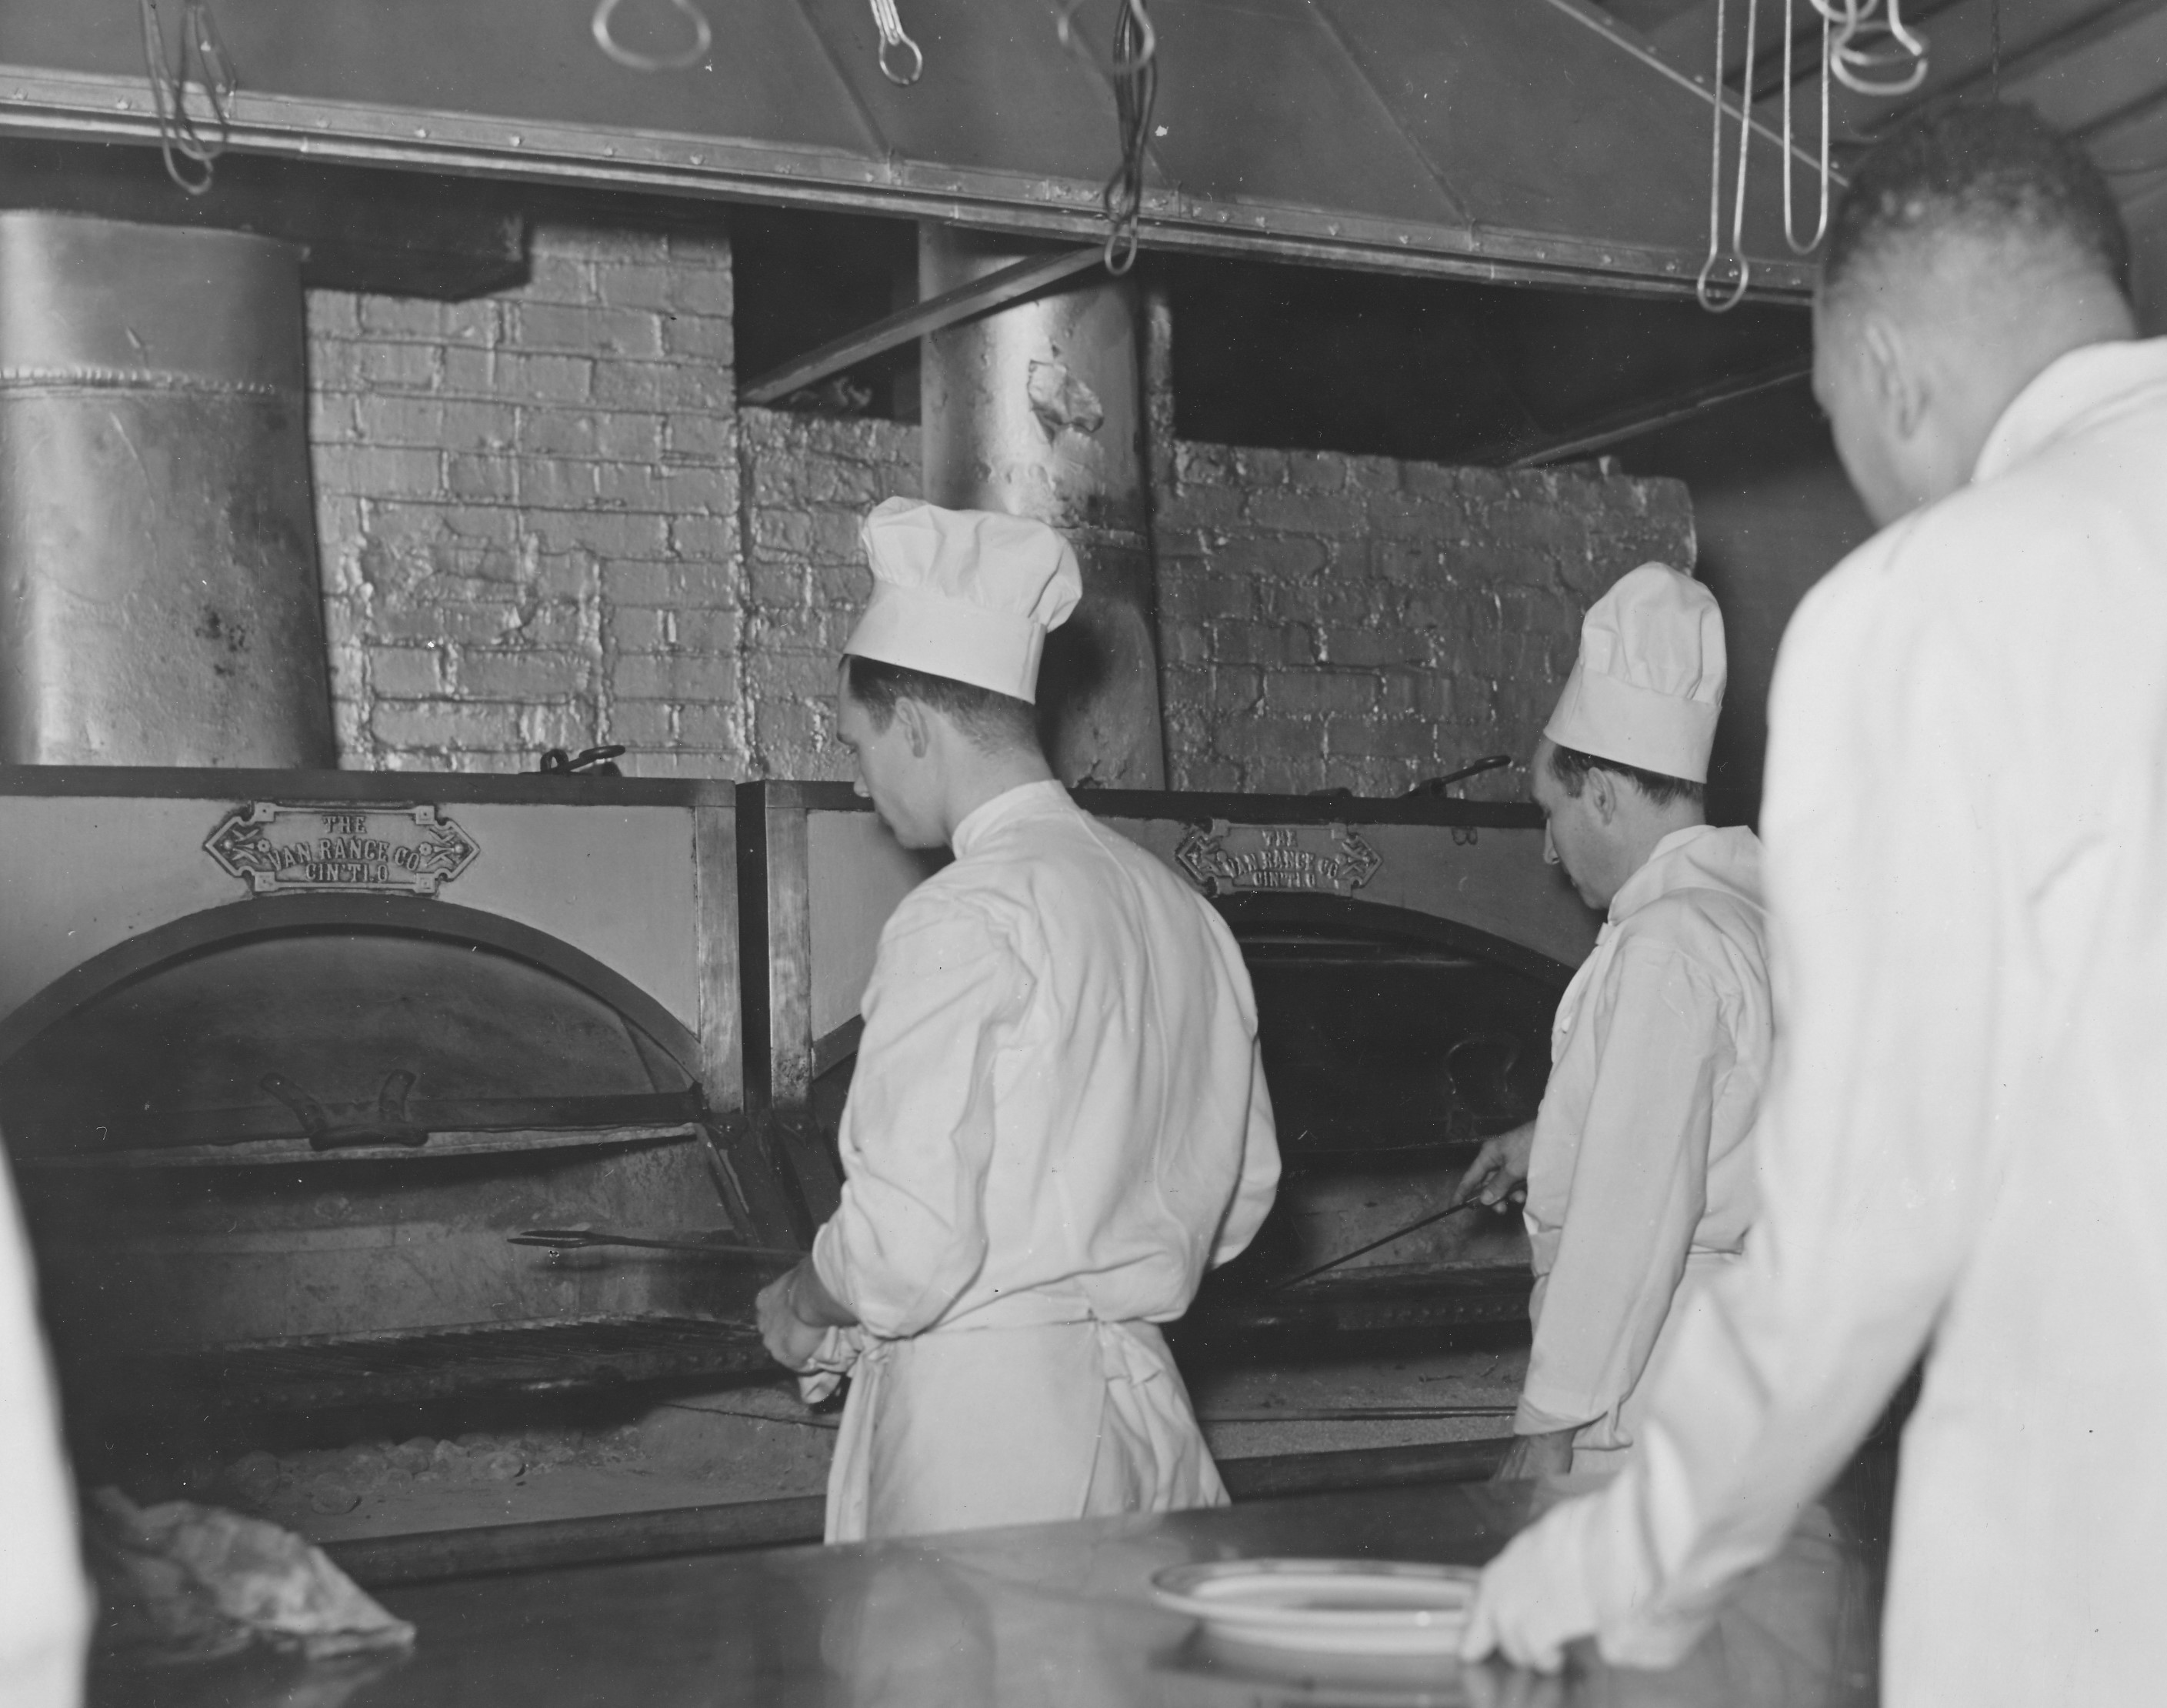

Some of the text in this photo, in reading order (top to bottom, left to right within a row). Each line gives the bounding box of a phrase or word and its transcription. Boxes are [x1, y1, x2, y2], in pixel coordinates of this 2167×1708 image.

[323, 816, 367, 833] THE
[1262, 829, 1298, 846] THE
[268, 842, 312, 871] VAN
[319, 837, 390, 862] RANGE
[1223, 853, 1258, 879] VAN
